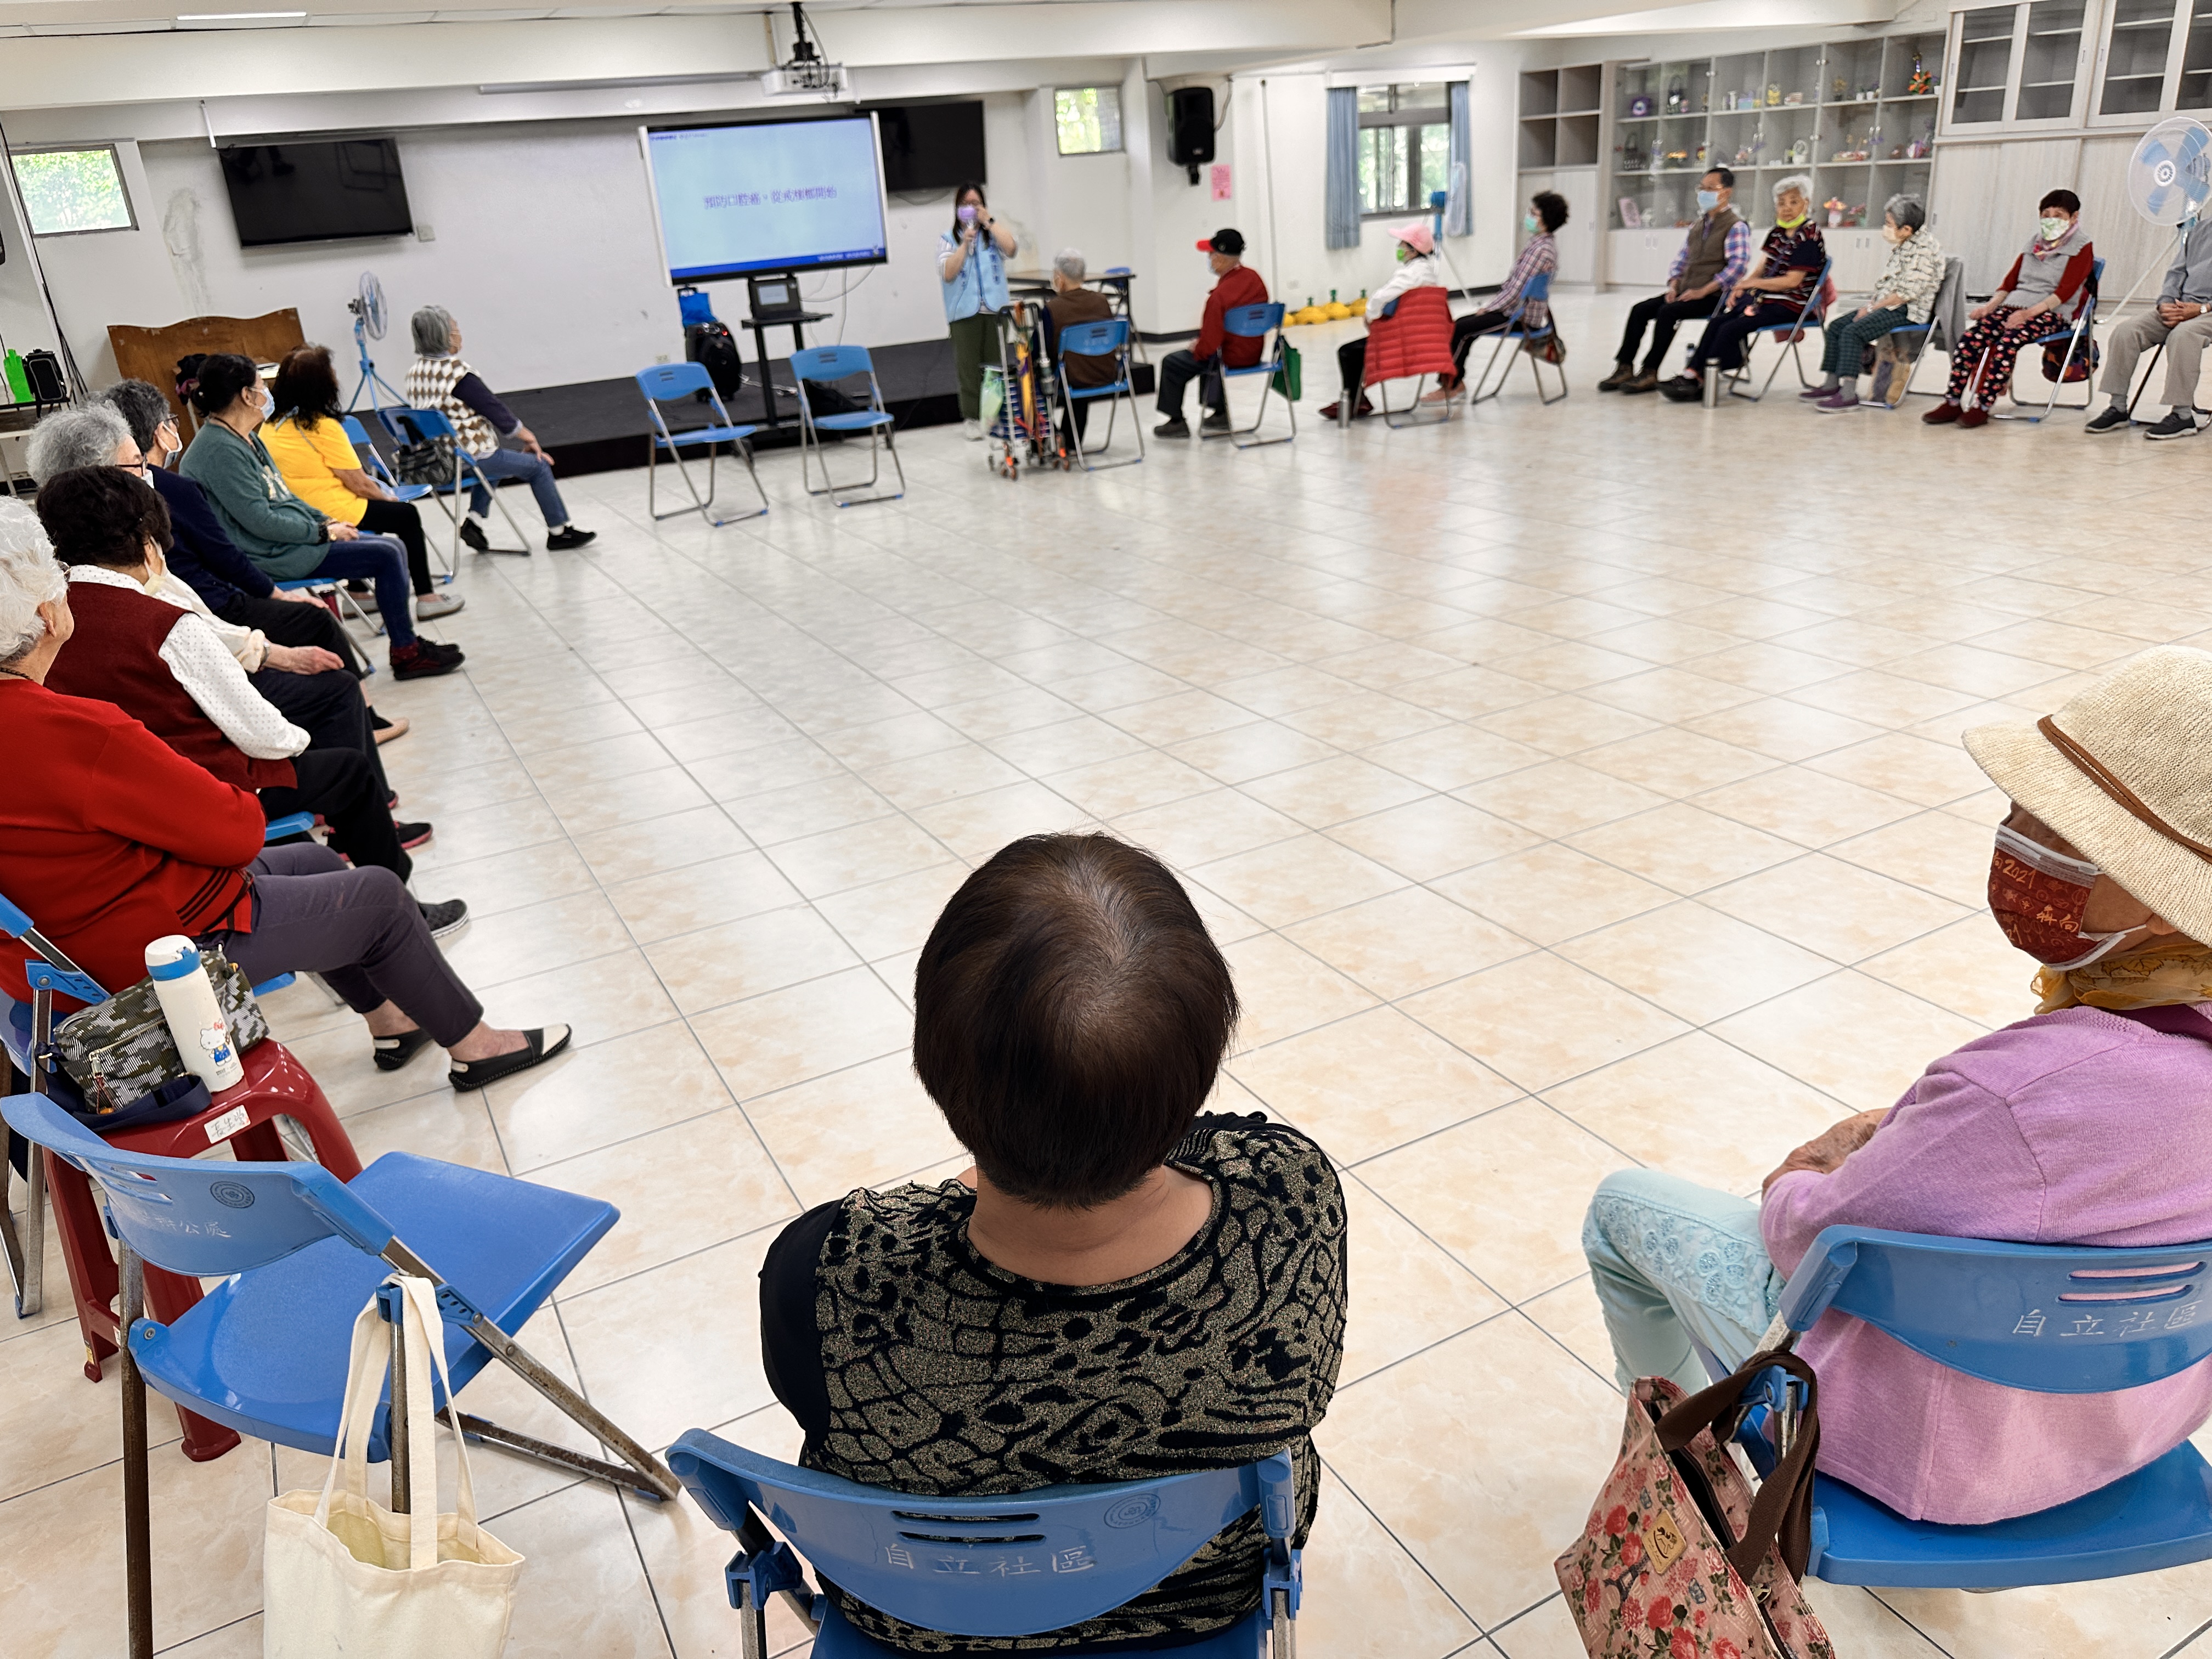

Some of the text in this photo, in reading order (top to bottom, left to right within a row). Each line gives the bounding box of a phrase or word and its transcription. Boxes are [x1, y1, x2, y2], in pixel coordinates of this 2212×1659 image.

[2012, 1300, 2203, 1338] 自立社區
[884, 1542, 1097, 1578] 自立社區
